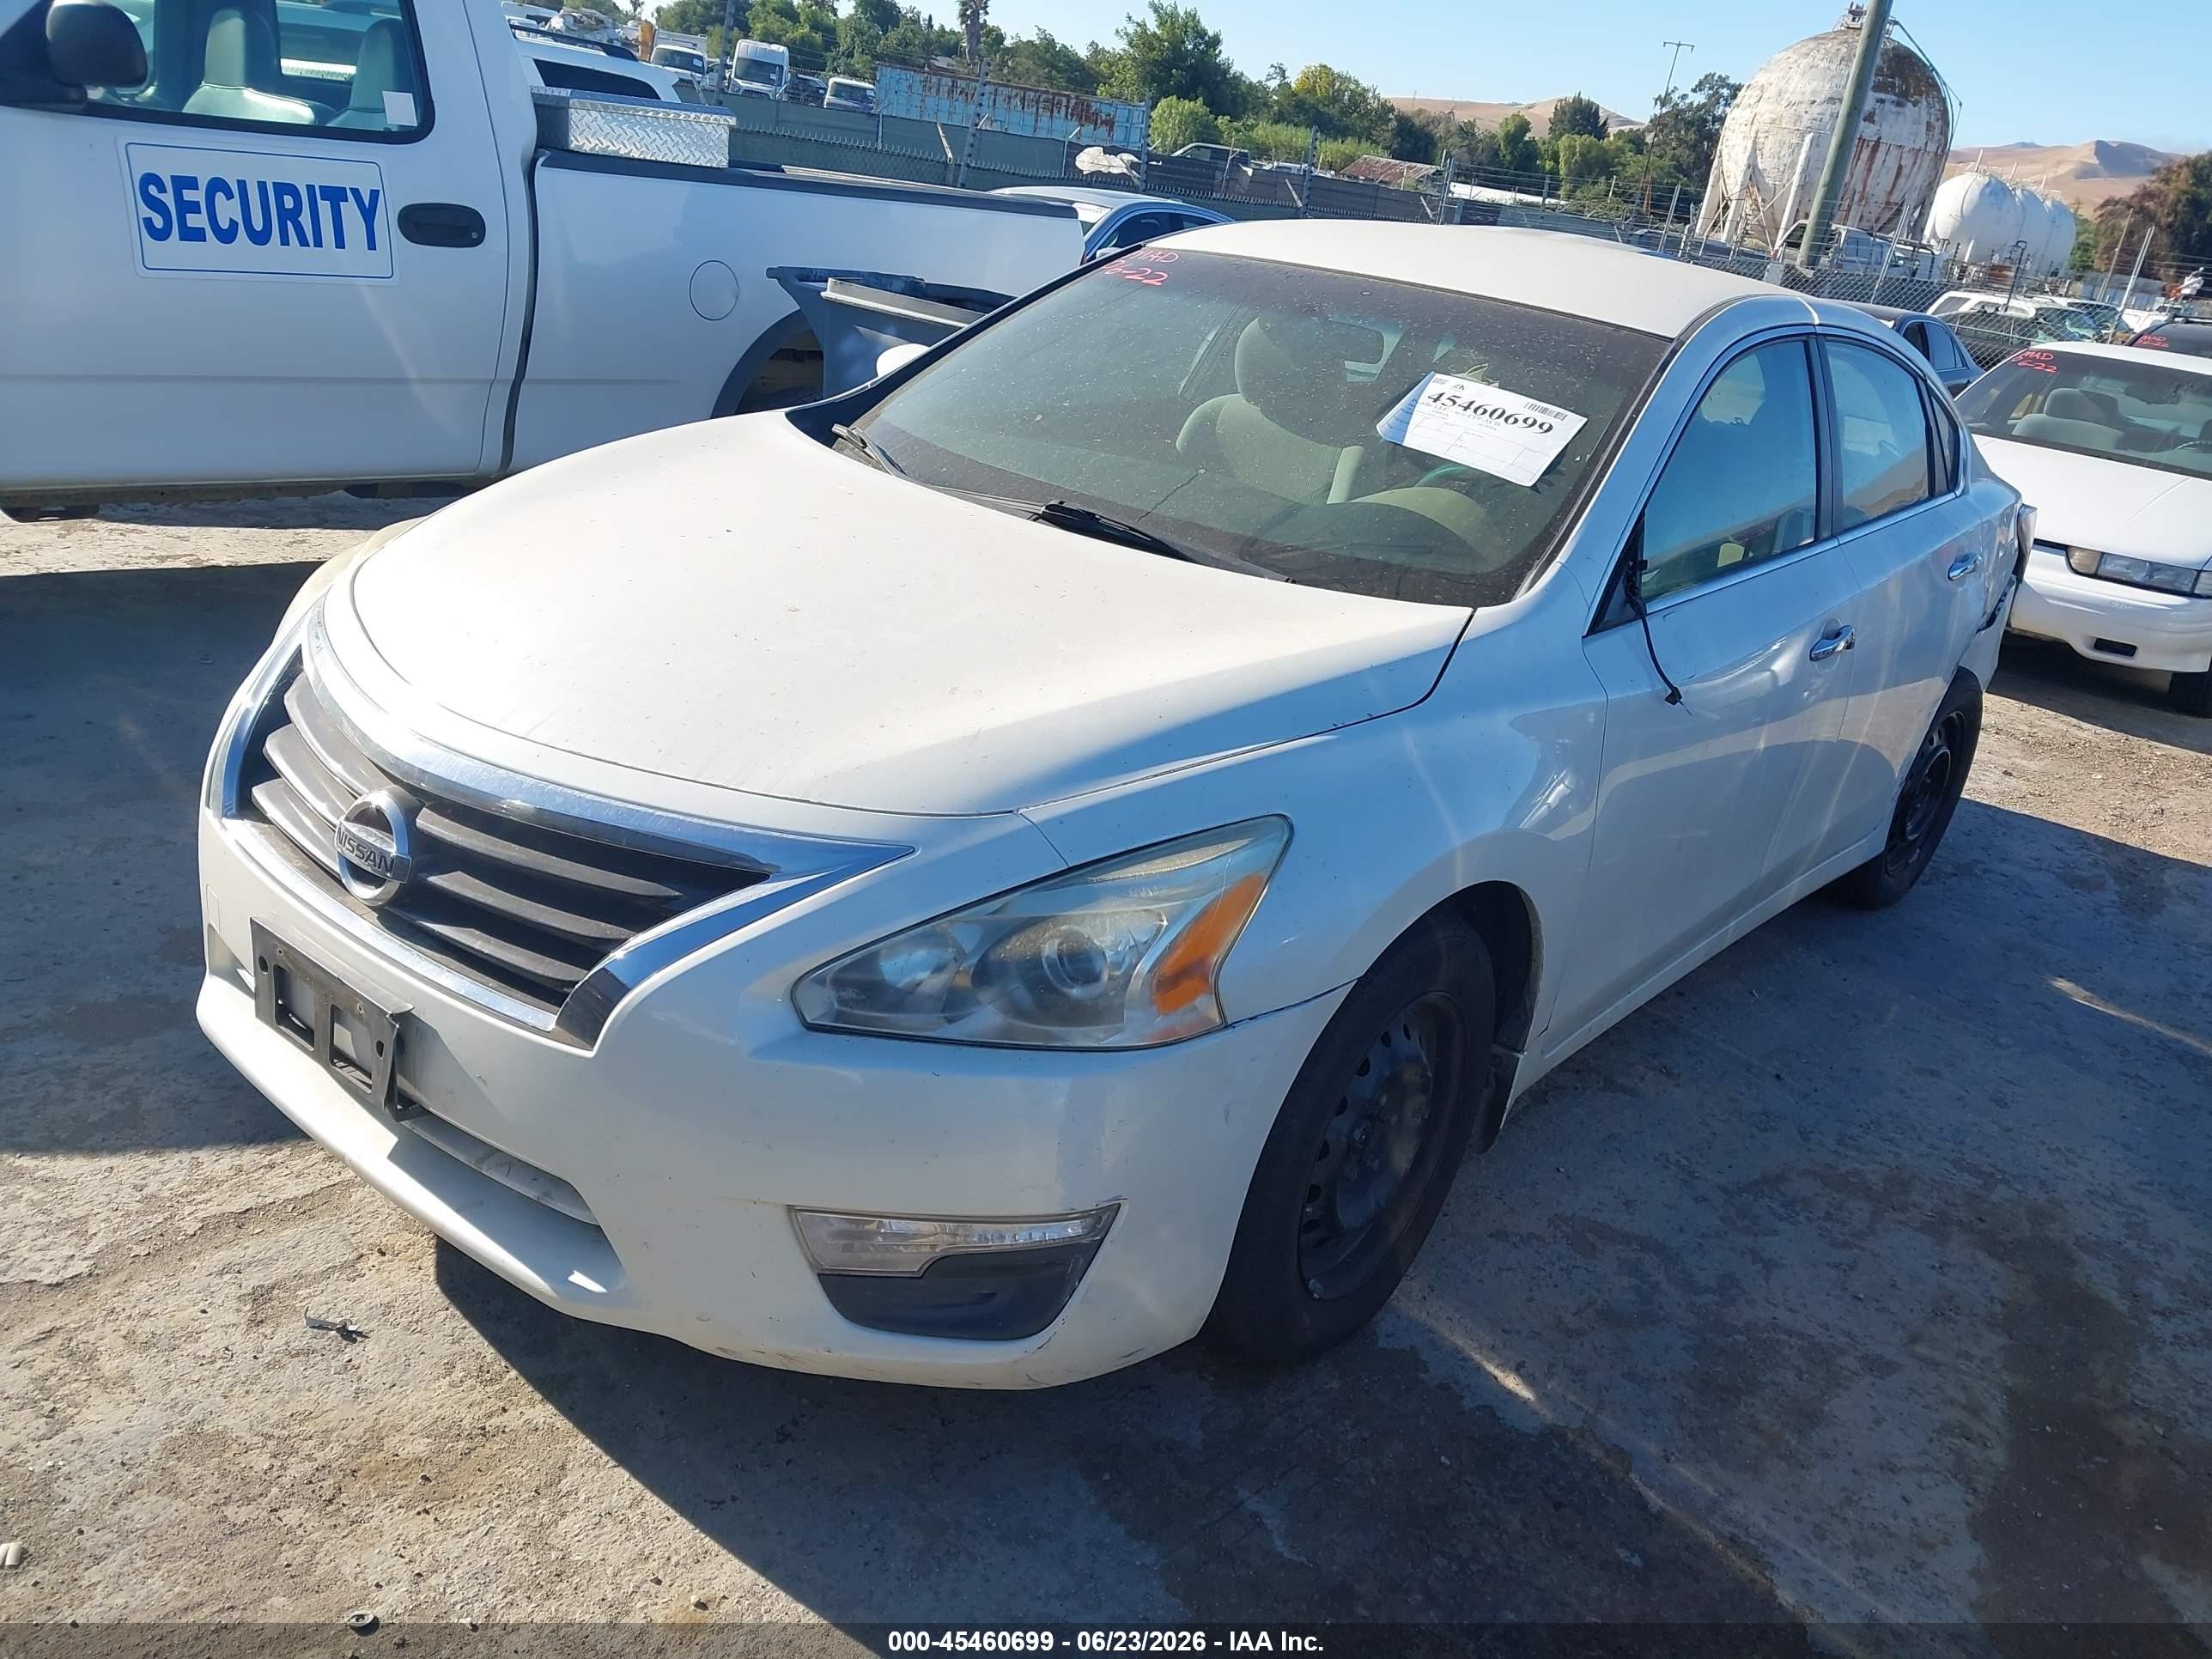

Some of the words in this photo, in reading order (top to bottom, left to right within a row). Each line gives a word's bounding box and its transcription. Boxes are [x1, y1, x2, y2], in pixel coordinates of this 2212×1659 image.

[138, 172, 380, 251] SECURITY
[1427, 392, 1554, 434] 45460699
[337, 826, 395, 874] NISSAN
